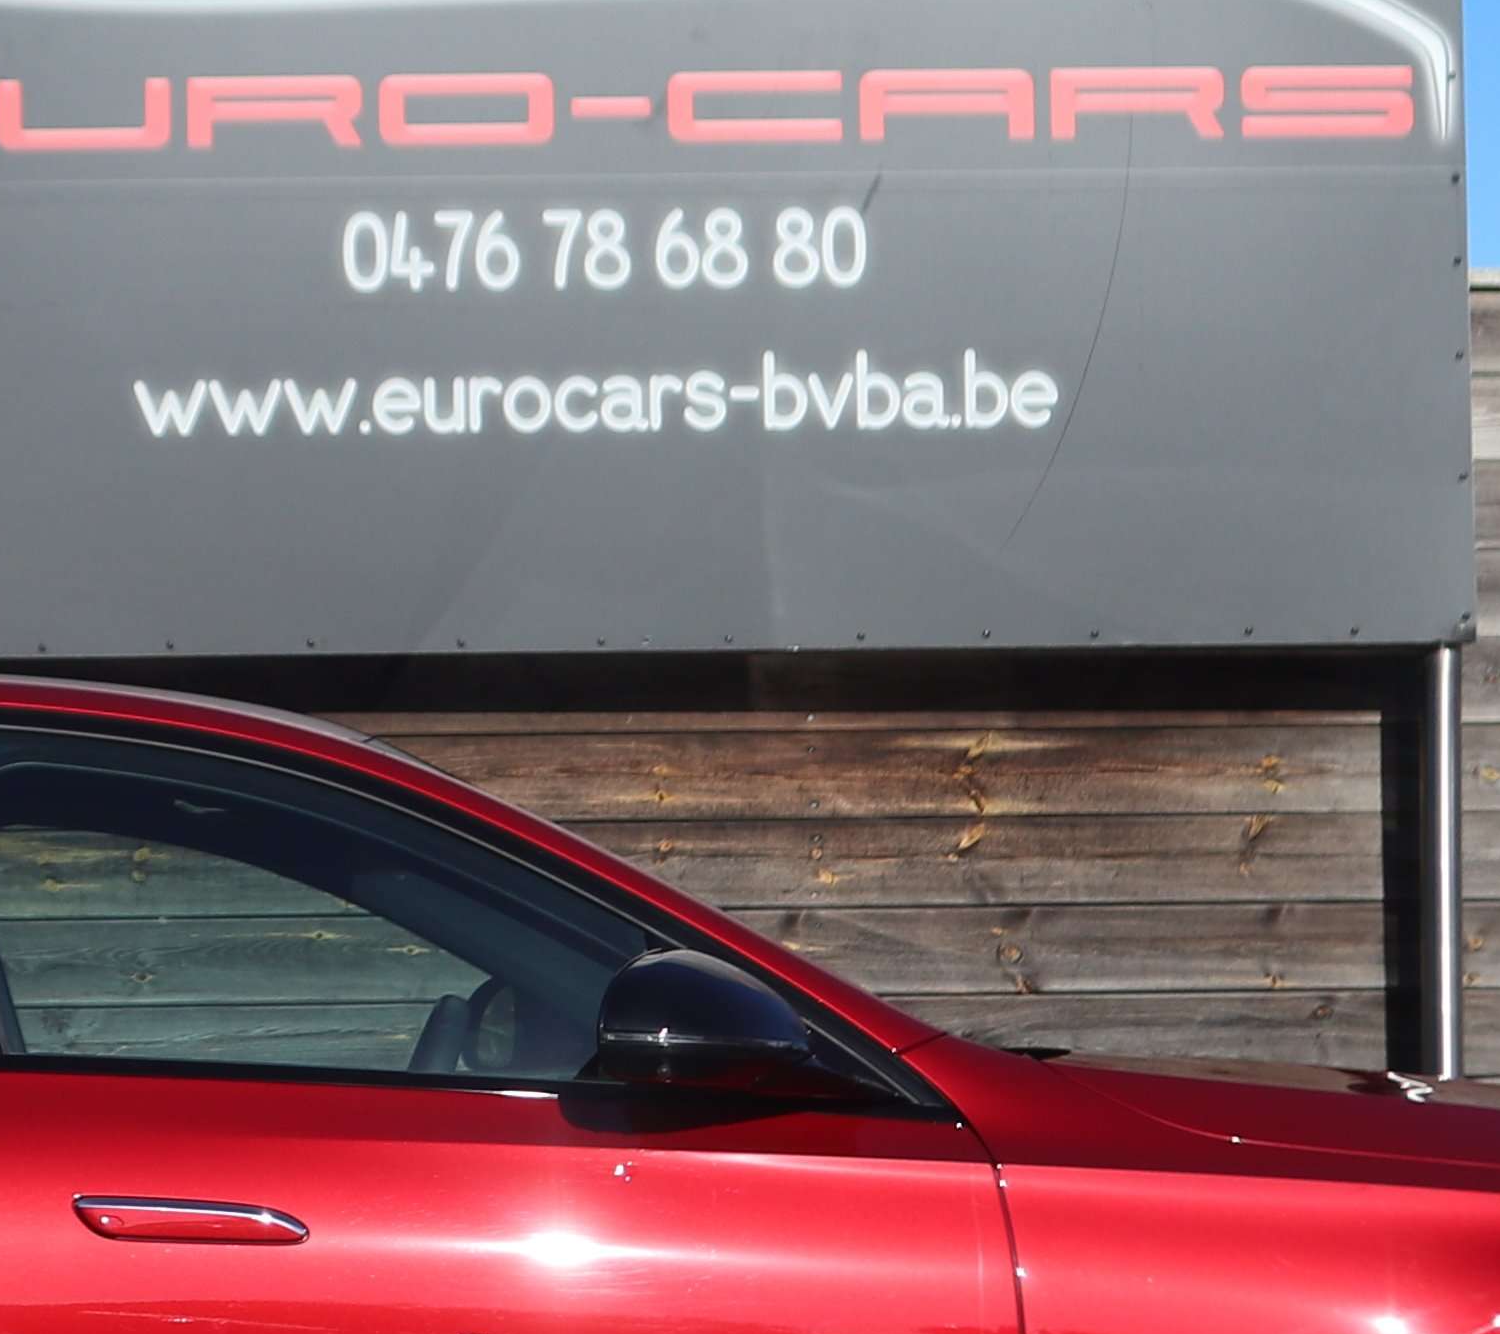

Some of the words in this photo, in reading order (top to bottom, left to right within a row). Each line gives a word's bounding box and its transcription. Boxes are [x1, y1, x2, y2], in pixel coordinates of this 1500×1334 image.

[339, 202, 523, 295] 0476
[539, 202, 634, 293] 78
[651, 203, 751, 292] 68
[769, 200, 869, 291] 80
[131, 345, 1060, 438] www.eurocars-bvba.be
